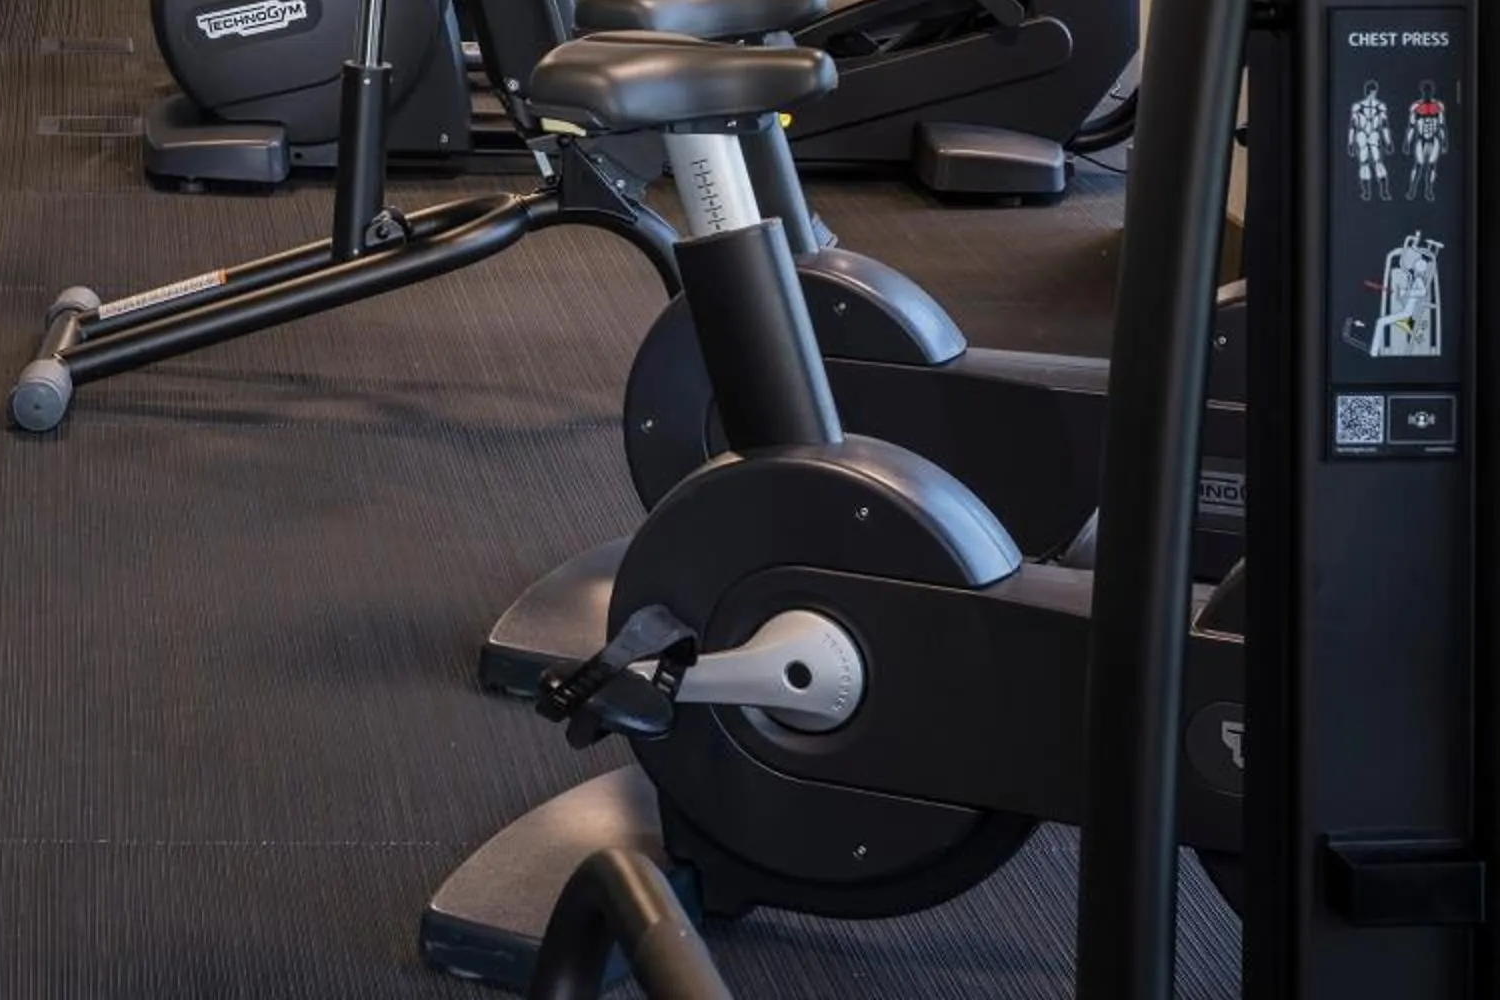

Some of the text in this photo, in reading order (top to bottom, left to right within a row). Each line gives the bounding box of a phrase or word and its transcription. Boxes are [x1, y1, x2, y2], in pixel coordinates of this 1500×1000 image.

[199, 3, 302, 33] TECHNOGYM
[1348, 31, 1449, 47] CHEST PRESS
